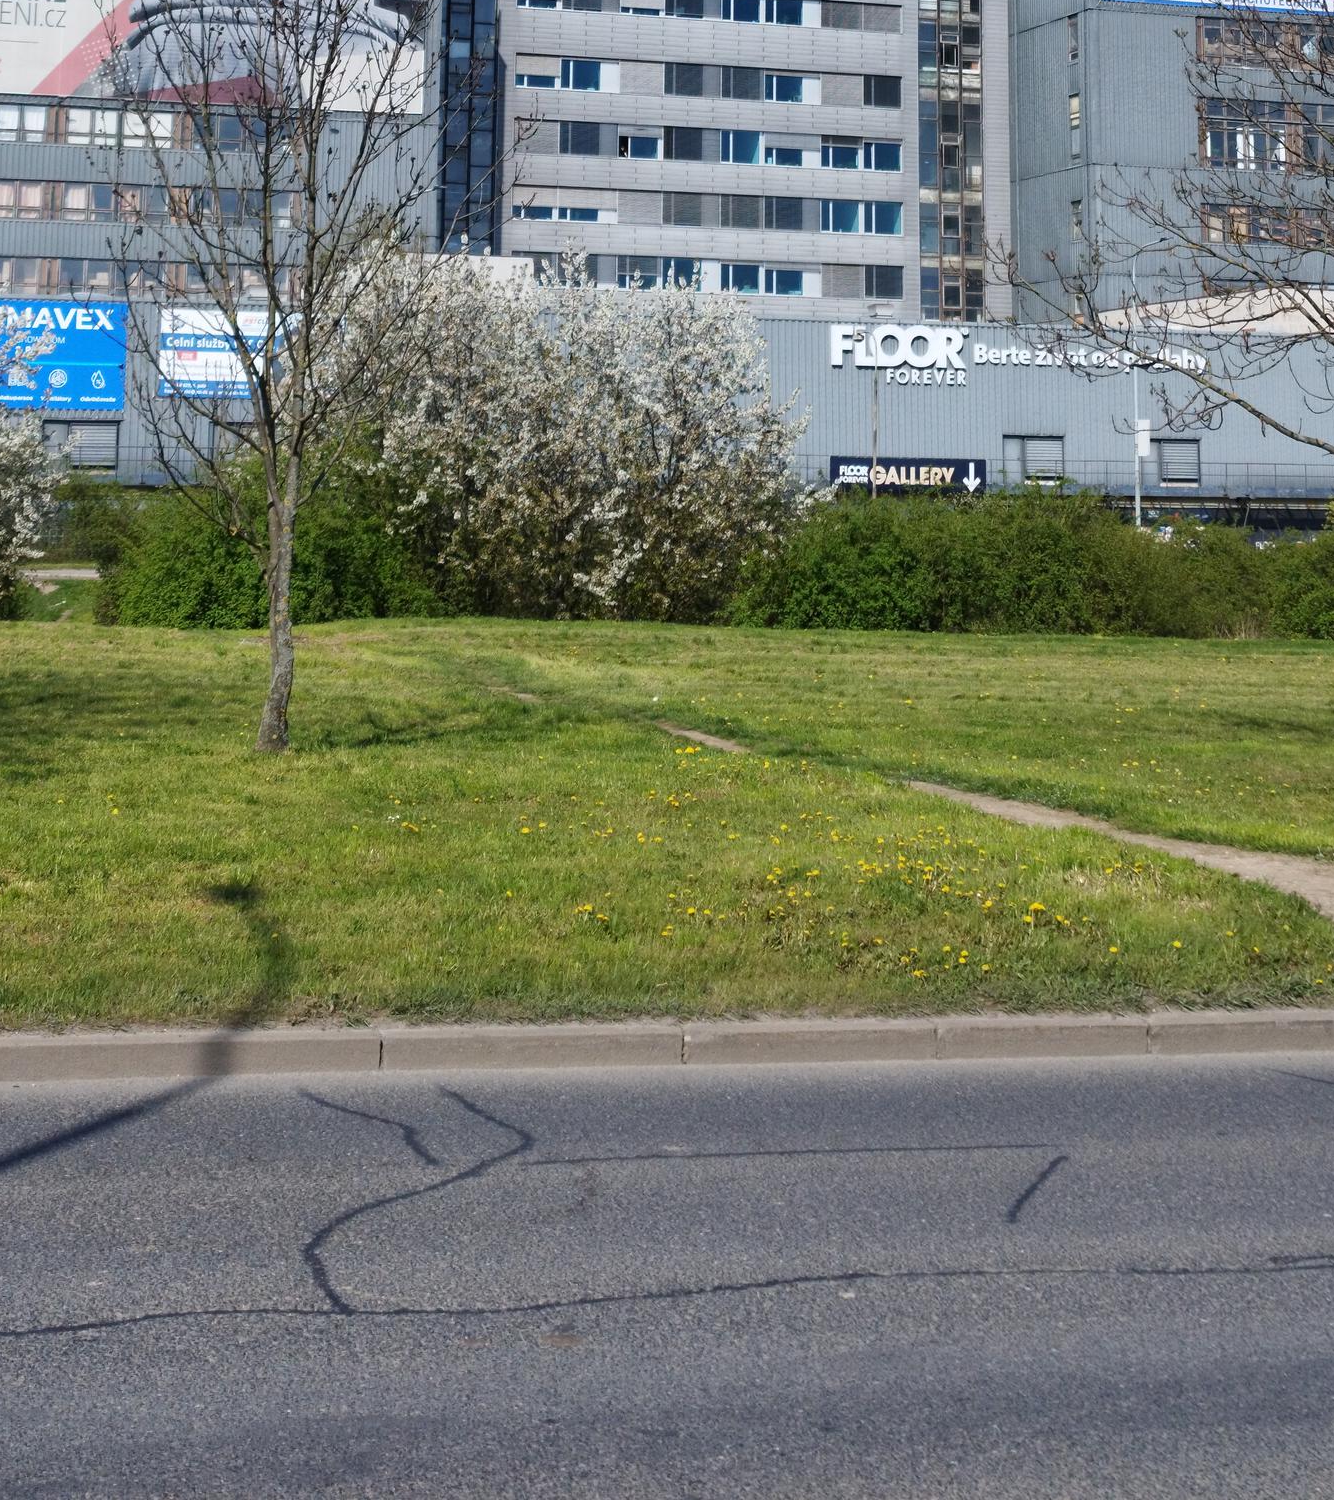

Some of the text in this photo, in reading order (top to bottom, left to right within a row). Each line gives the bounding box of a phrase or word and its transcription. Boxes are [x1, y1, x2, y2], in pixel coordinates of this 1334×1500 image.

[167, 337, 194, 348] Celní
[197, 337, 230, 350] služby
[830, 324, 965, 369] FLOOR
[974, 343, 1208, 374] Berte život od pdlahy
[886, 368, 967, 386] FOREVER
[839, 465, 956, 486] FLOOR GALLERY
